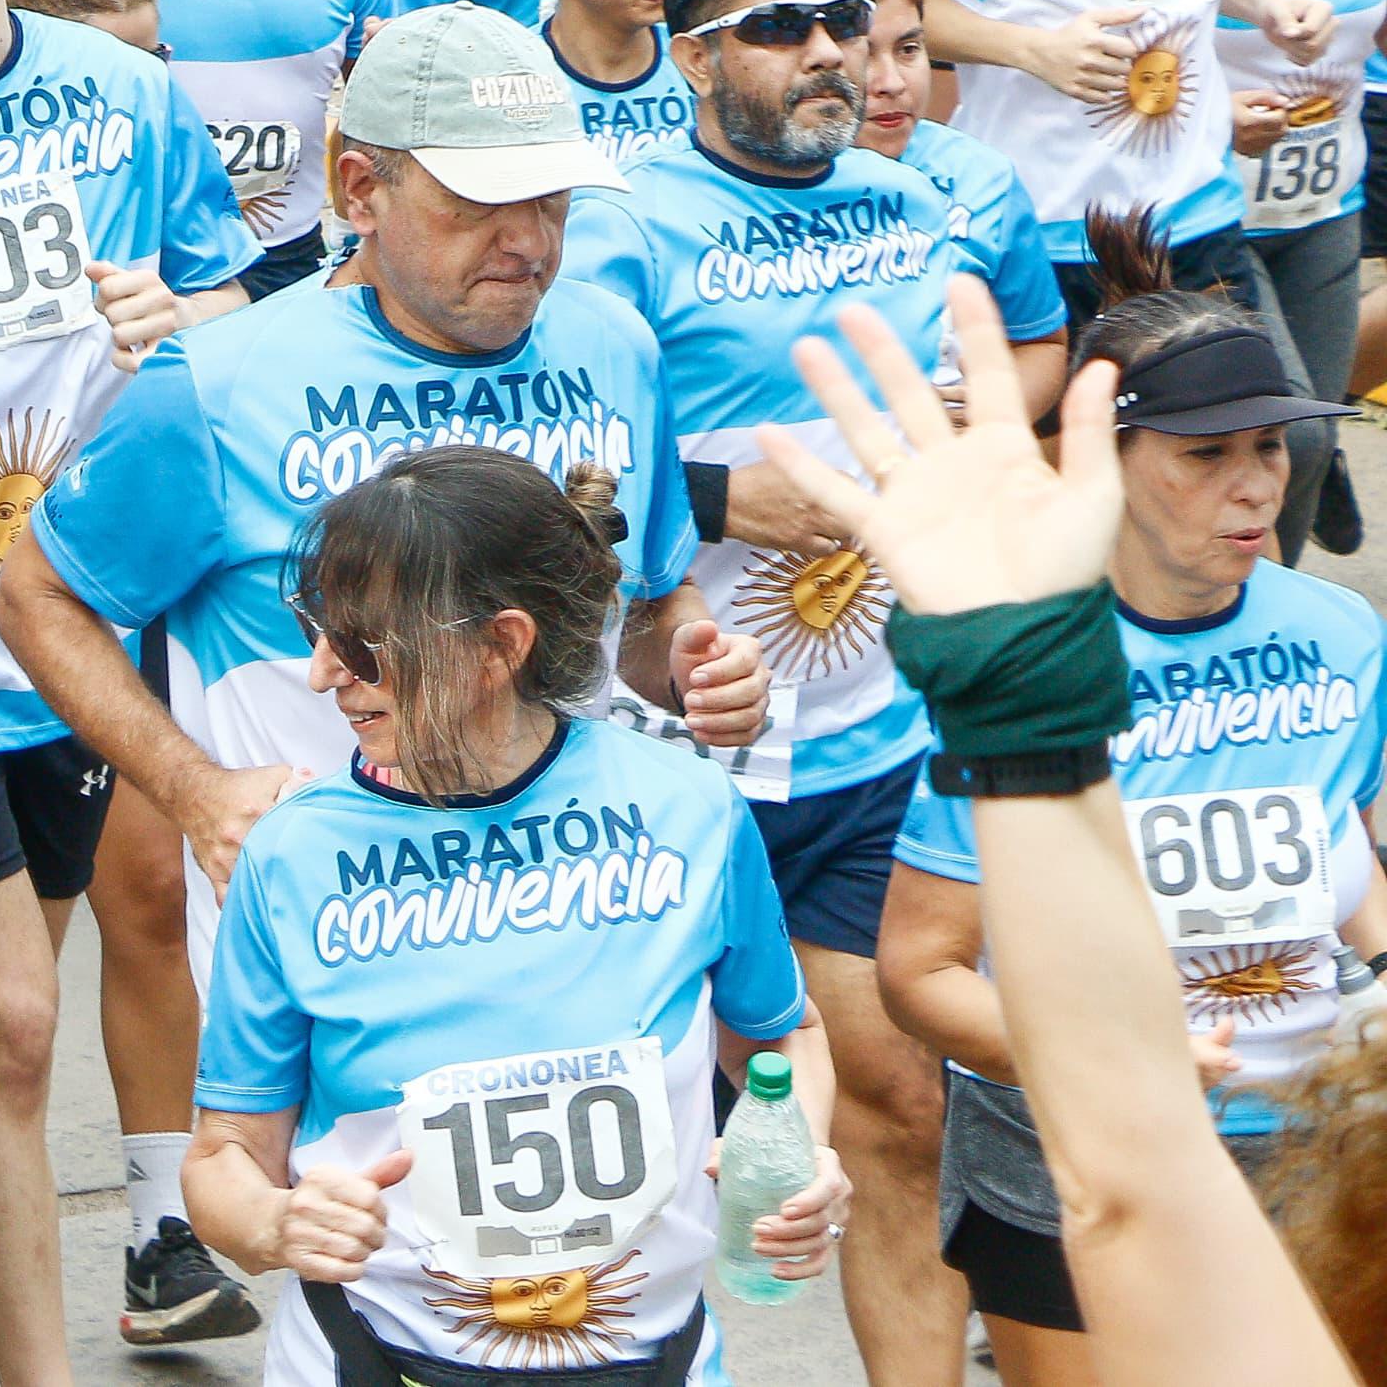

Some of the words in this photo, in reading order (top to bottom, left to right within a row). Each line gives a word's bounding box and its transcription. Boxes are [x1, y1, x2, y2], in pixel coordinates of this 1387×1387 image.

[581, 86, 690, 135] RATÓ
[211, 124, 286, 178] 20
[1256, 137, 1340, 205] 138
[1130, 631, 1323, 705] ARATÓN
[335, 800, 645, 897] MARATÓN
[1138, 793, 1313, 897] 603
[314, 829, 687, 968] convivencia
[427, 1049, 628, 1096] CRONONEA
[422, 1084, 647, 1217] 150
